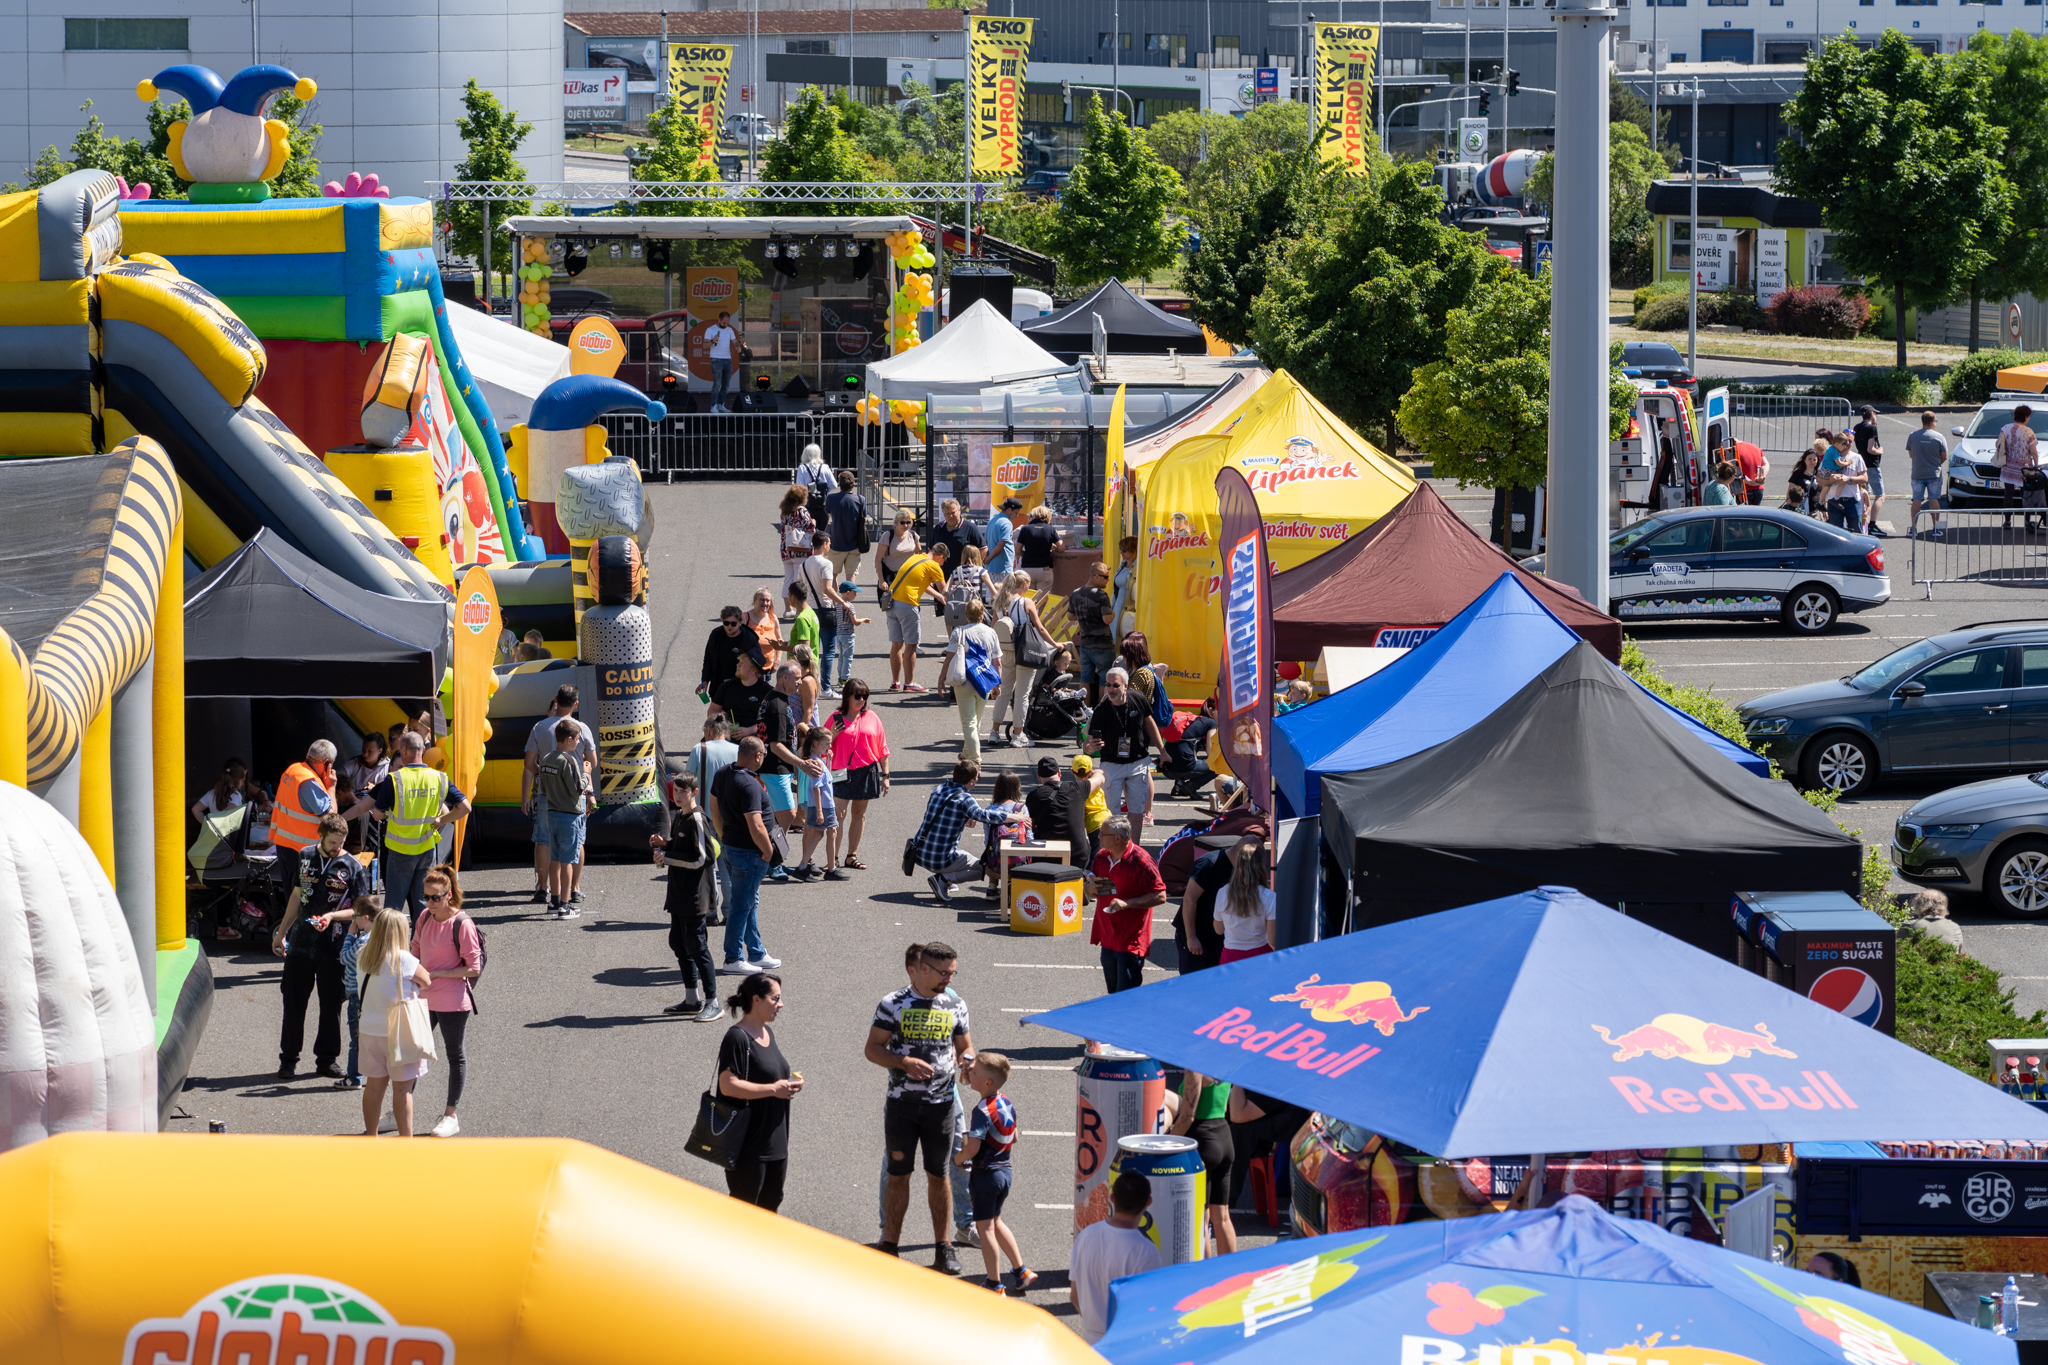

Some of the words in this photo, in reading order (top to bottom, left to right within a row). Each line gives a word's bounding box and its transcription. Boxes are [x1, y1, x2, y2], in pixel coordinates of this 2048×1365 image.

[976, 20, 1026, 35] ASKO
[1322, 27, 1372, 40] ASKO
[675, 47, 726, 61] ASKO
[977, 52, 998, 141] VELKÝ
[1322, 58, 1346, 143] VELKÝ
[568, 108, 591, 120] OJETÉ
[594, 110, 616, 118] VOZY
[1697, 247, 1722, 258] DVEŘE
[997, 462, 1038, 482] Globus
[1246, 462, 1359, 494] Lipánek
[1264, 521, 1316, 540] ipánkův
[1318, 522, 1350, 540] svět
[1148, 531, 1208, 560] Lipánek
[464, 600, 490, 624] Globus
[605, 665, 653, 683] CAUTI
[606, 687, 622, 695] DO
[625, 684, 645, 695] NOT
[600, 729, 636, 742] ROSS!
[1016, 899, 1048, 911] Pedigree
[1807, 951, 1838, 960] ZERO
[1842, 951, 1883, 960] SUGAR
[903, 1011, 952, 1024] RESIST
[1967, 1178, 2012, 1197] BIR
[1967, 1198, 2010, 1218] GO
